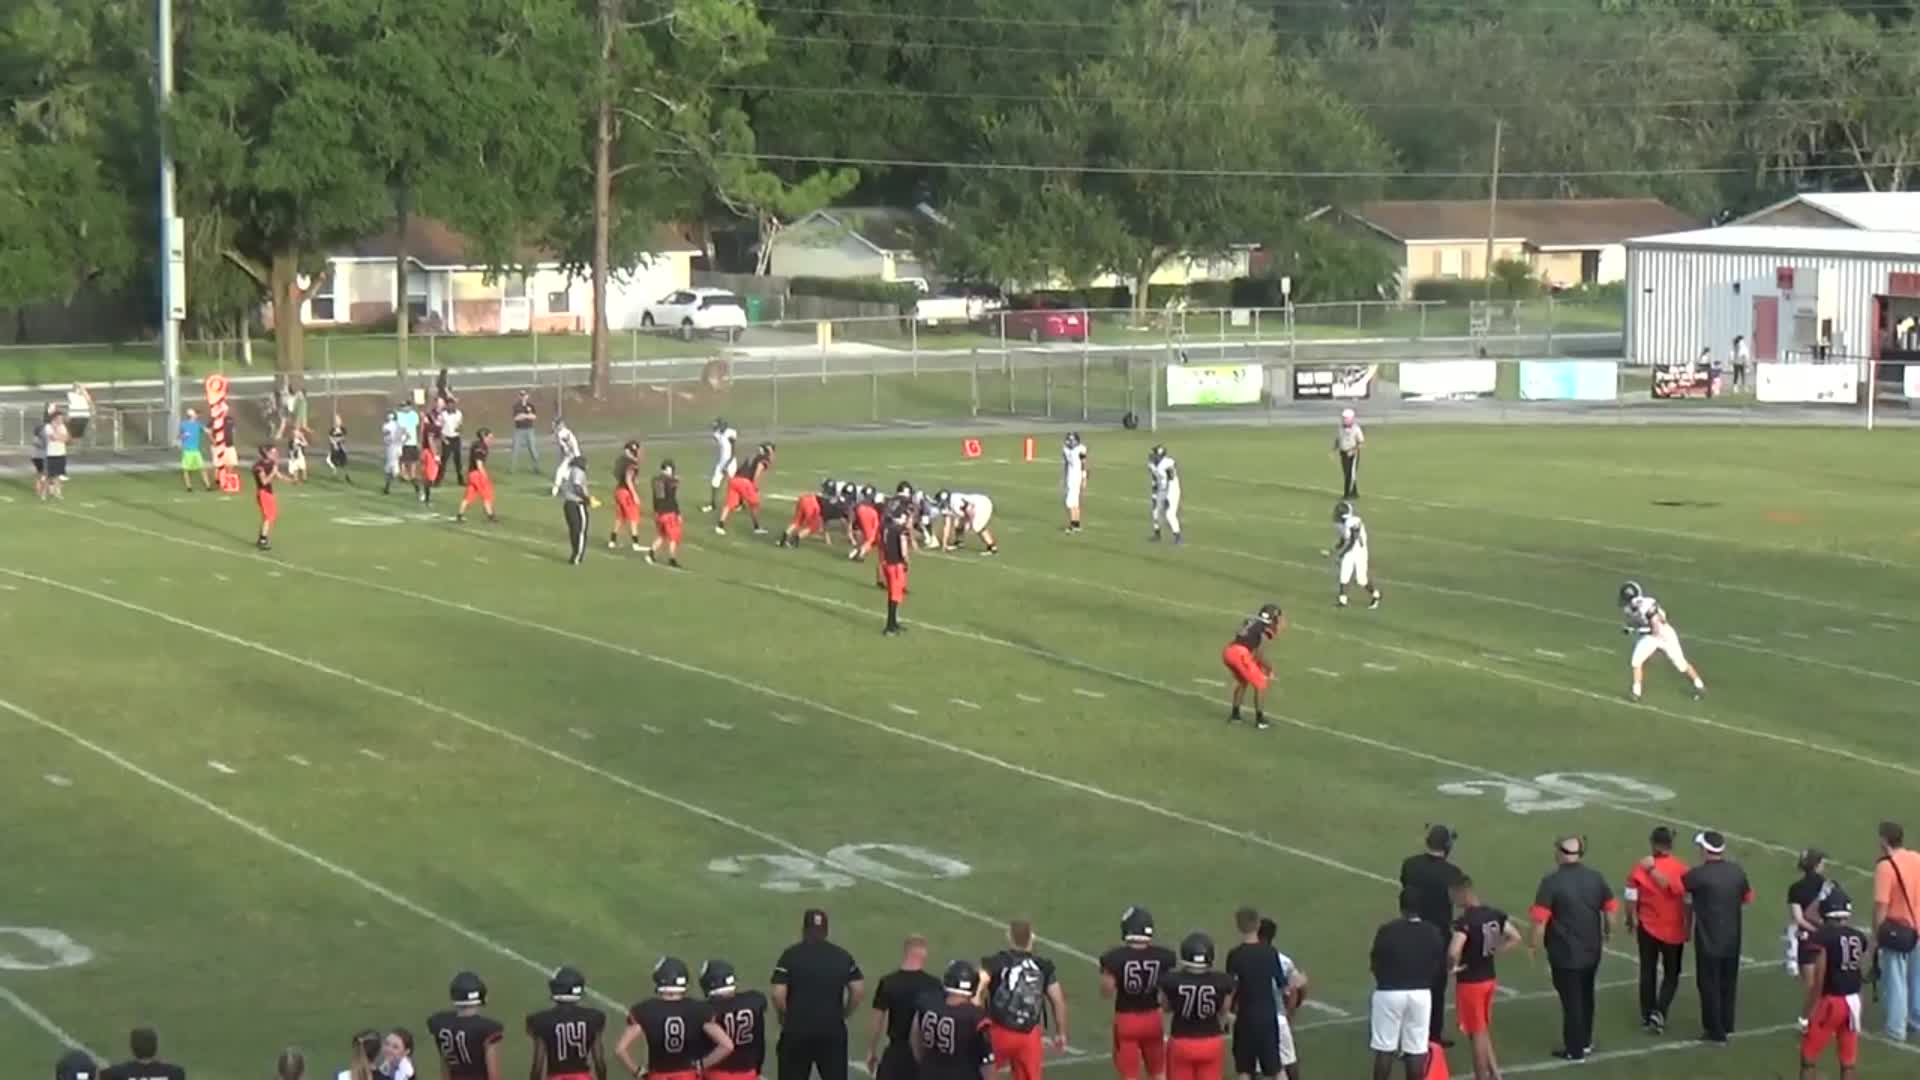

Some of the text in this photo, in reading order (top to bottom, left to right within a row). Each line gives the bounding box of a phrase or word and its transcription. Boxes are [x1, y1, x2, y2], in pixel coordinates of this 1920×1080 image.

[1436, 772, 1677, 814] 20
[1124, 960, 1160, 993] 67
[1178, 984, 1216, 1019] 76
[555, 1021, 587, 1061] 14
[665, 1016, 685, 1052] 8
[724, 1008, 754, 1045] 12
[439, 1027, 472, 1064] 21
